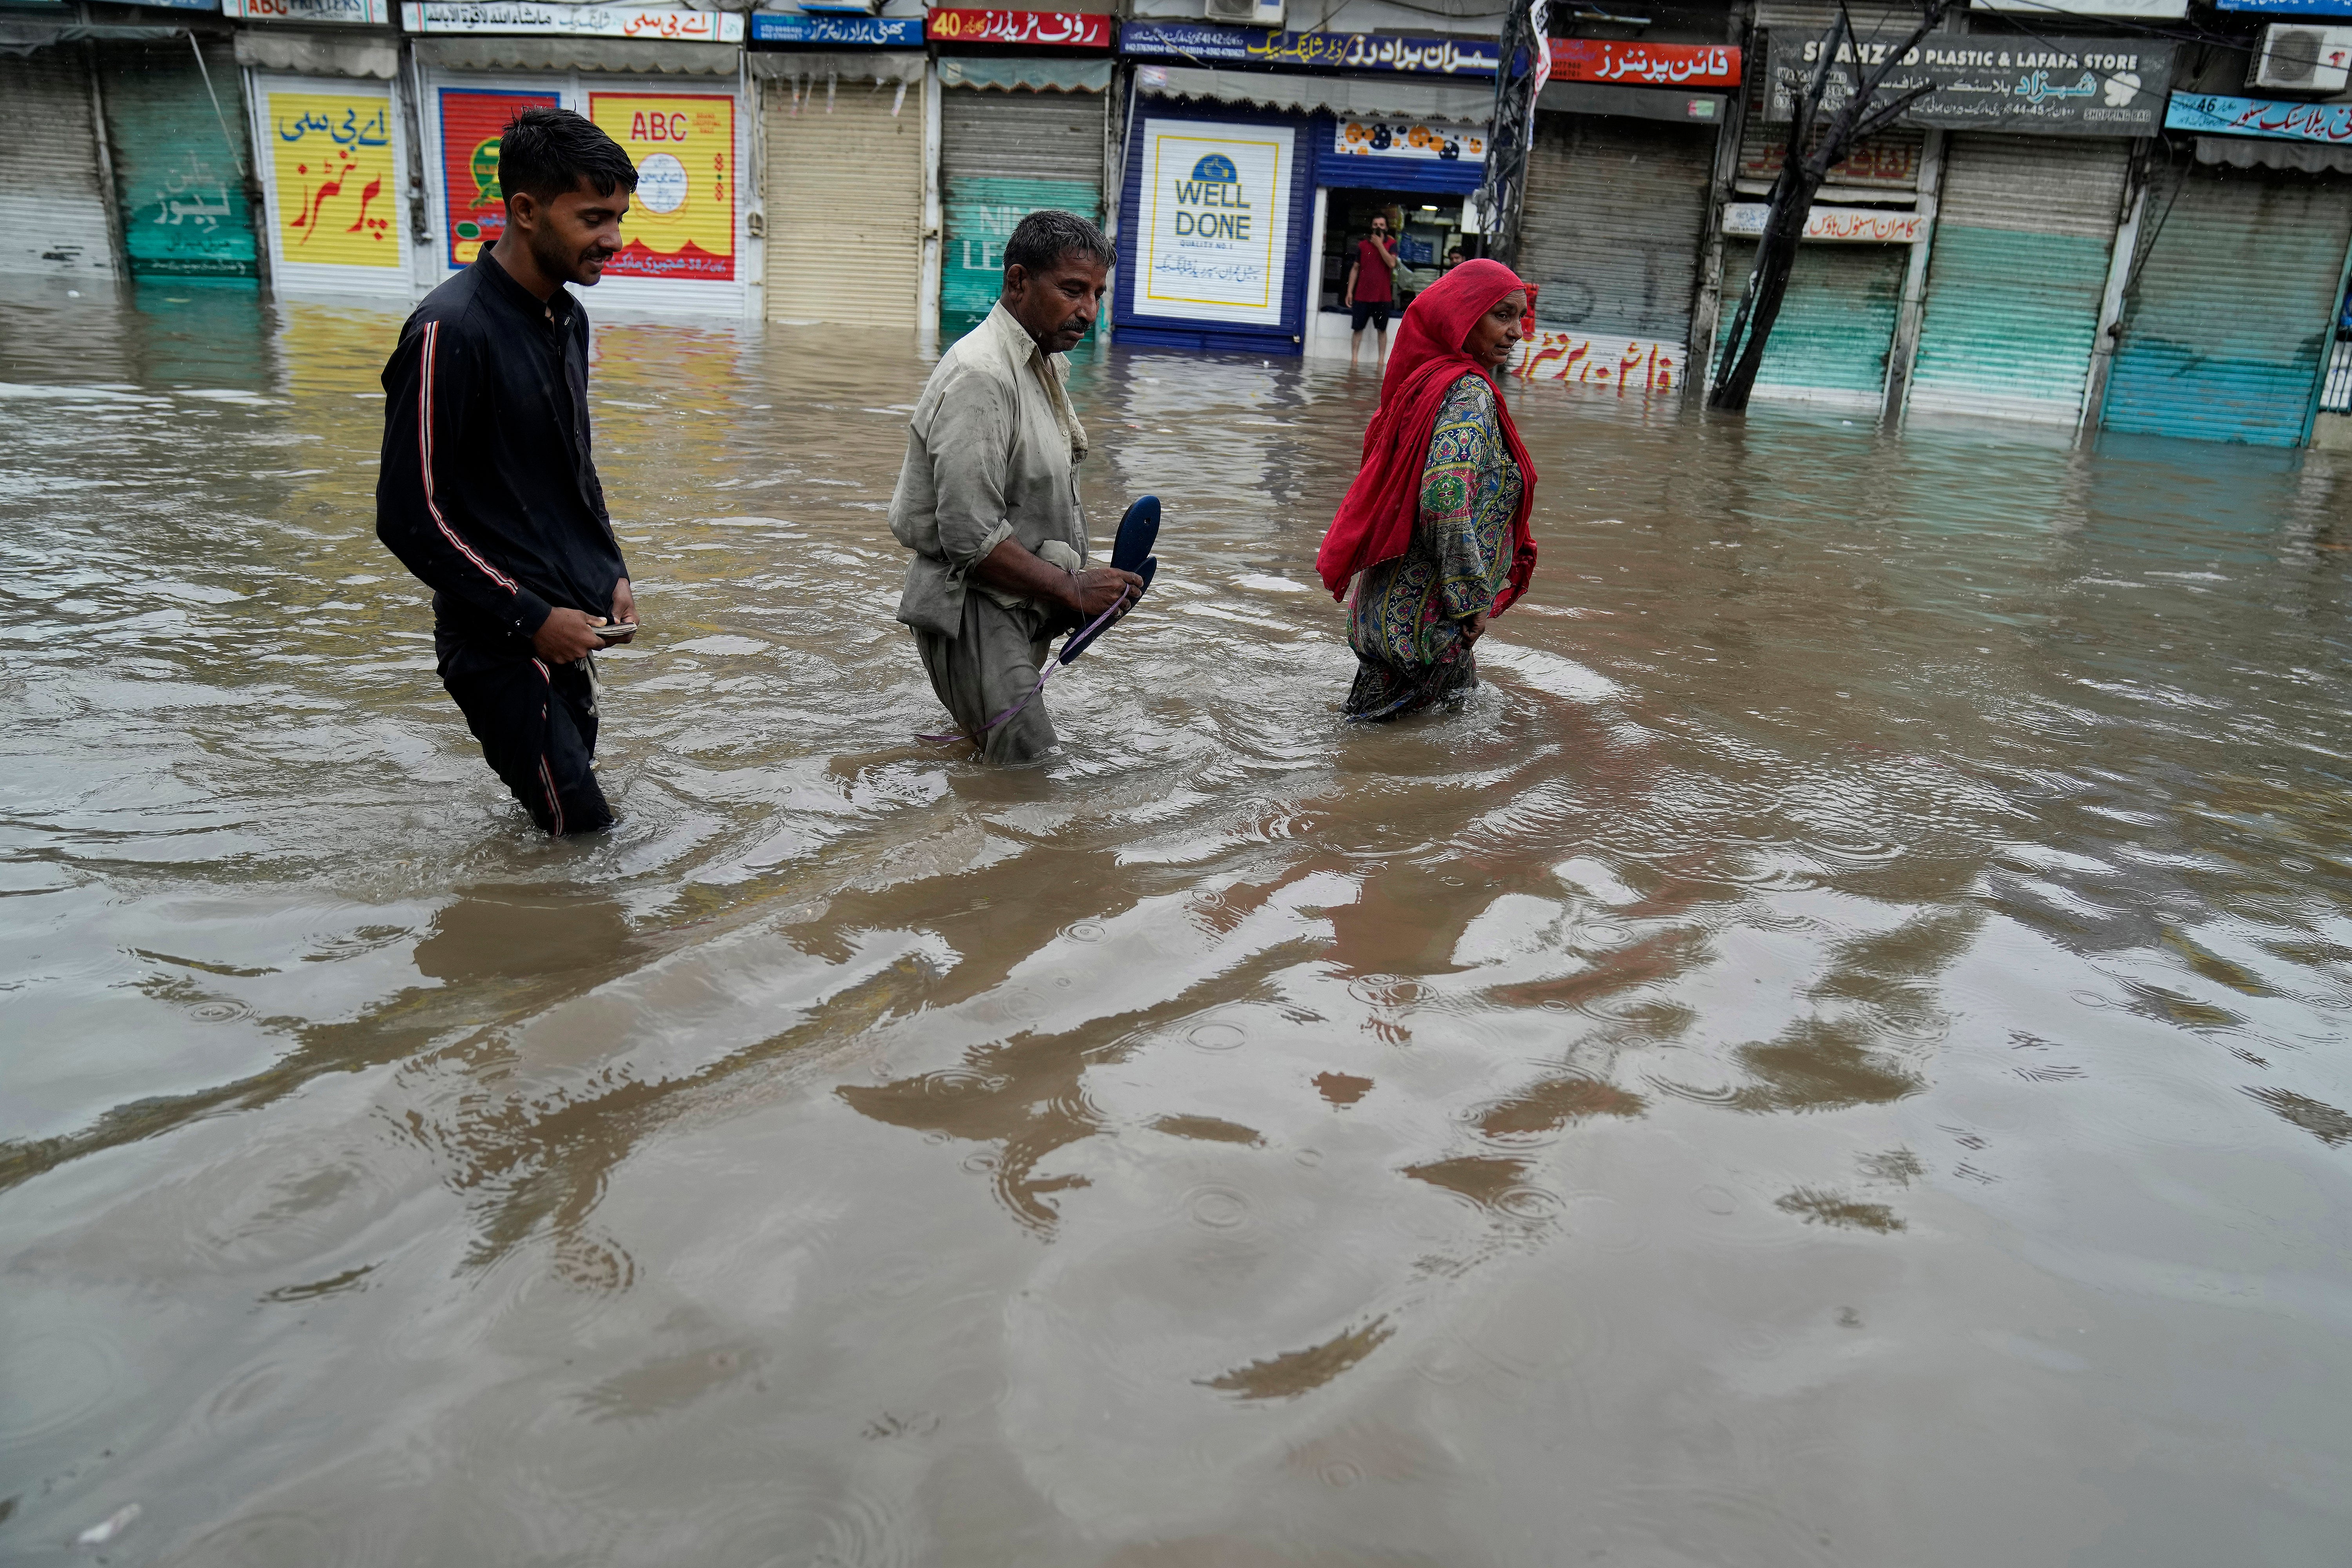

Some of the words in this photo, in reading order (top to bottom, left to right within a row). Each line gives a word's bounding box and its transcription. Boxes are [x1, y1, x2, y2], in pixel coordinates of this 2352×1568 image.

[624, 12, 661, 36] سی
[661, 13, 680, 37] بی
[682, 13, 709, 34] اے
[932, 12, 961, 36] 40
[1422, 39, 1499, 73] مران
[1595, 44, 1670, 83] پرنٹرز
[1669, 48, 1729, 82] فائن
[1925, 48, 1994, 67] PLASTIC
[1997, 51, 2011, 67] &
[2083, 53, 2138, 71] STORE
[2014, 68, 2097, 104] شہزاد
[2083, 107, 2131, 122] SHOPPING
[2196, 97, 2216, 112] 46
[279, 111, 328, 141] سی
[331, 108, 357, 152] بی
[358, 107, 390, 147] اے
[631, 111, 688, 141] ABC
[289, 150, 388, 246] پرنٹرز
[1175, 179, 1251, 209] WELL
[1176, 209, 1251, 241] DONE
[1179, 239, 1213, 248] QUALITY
